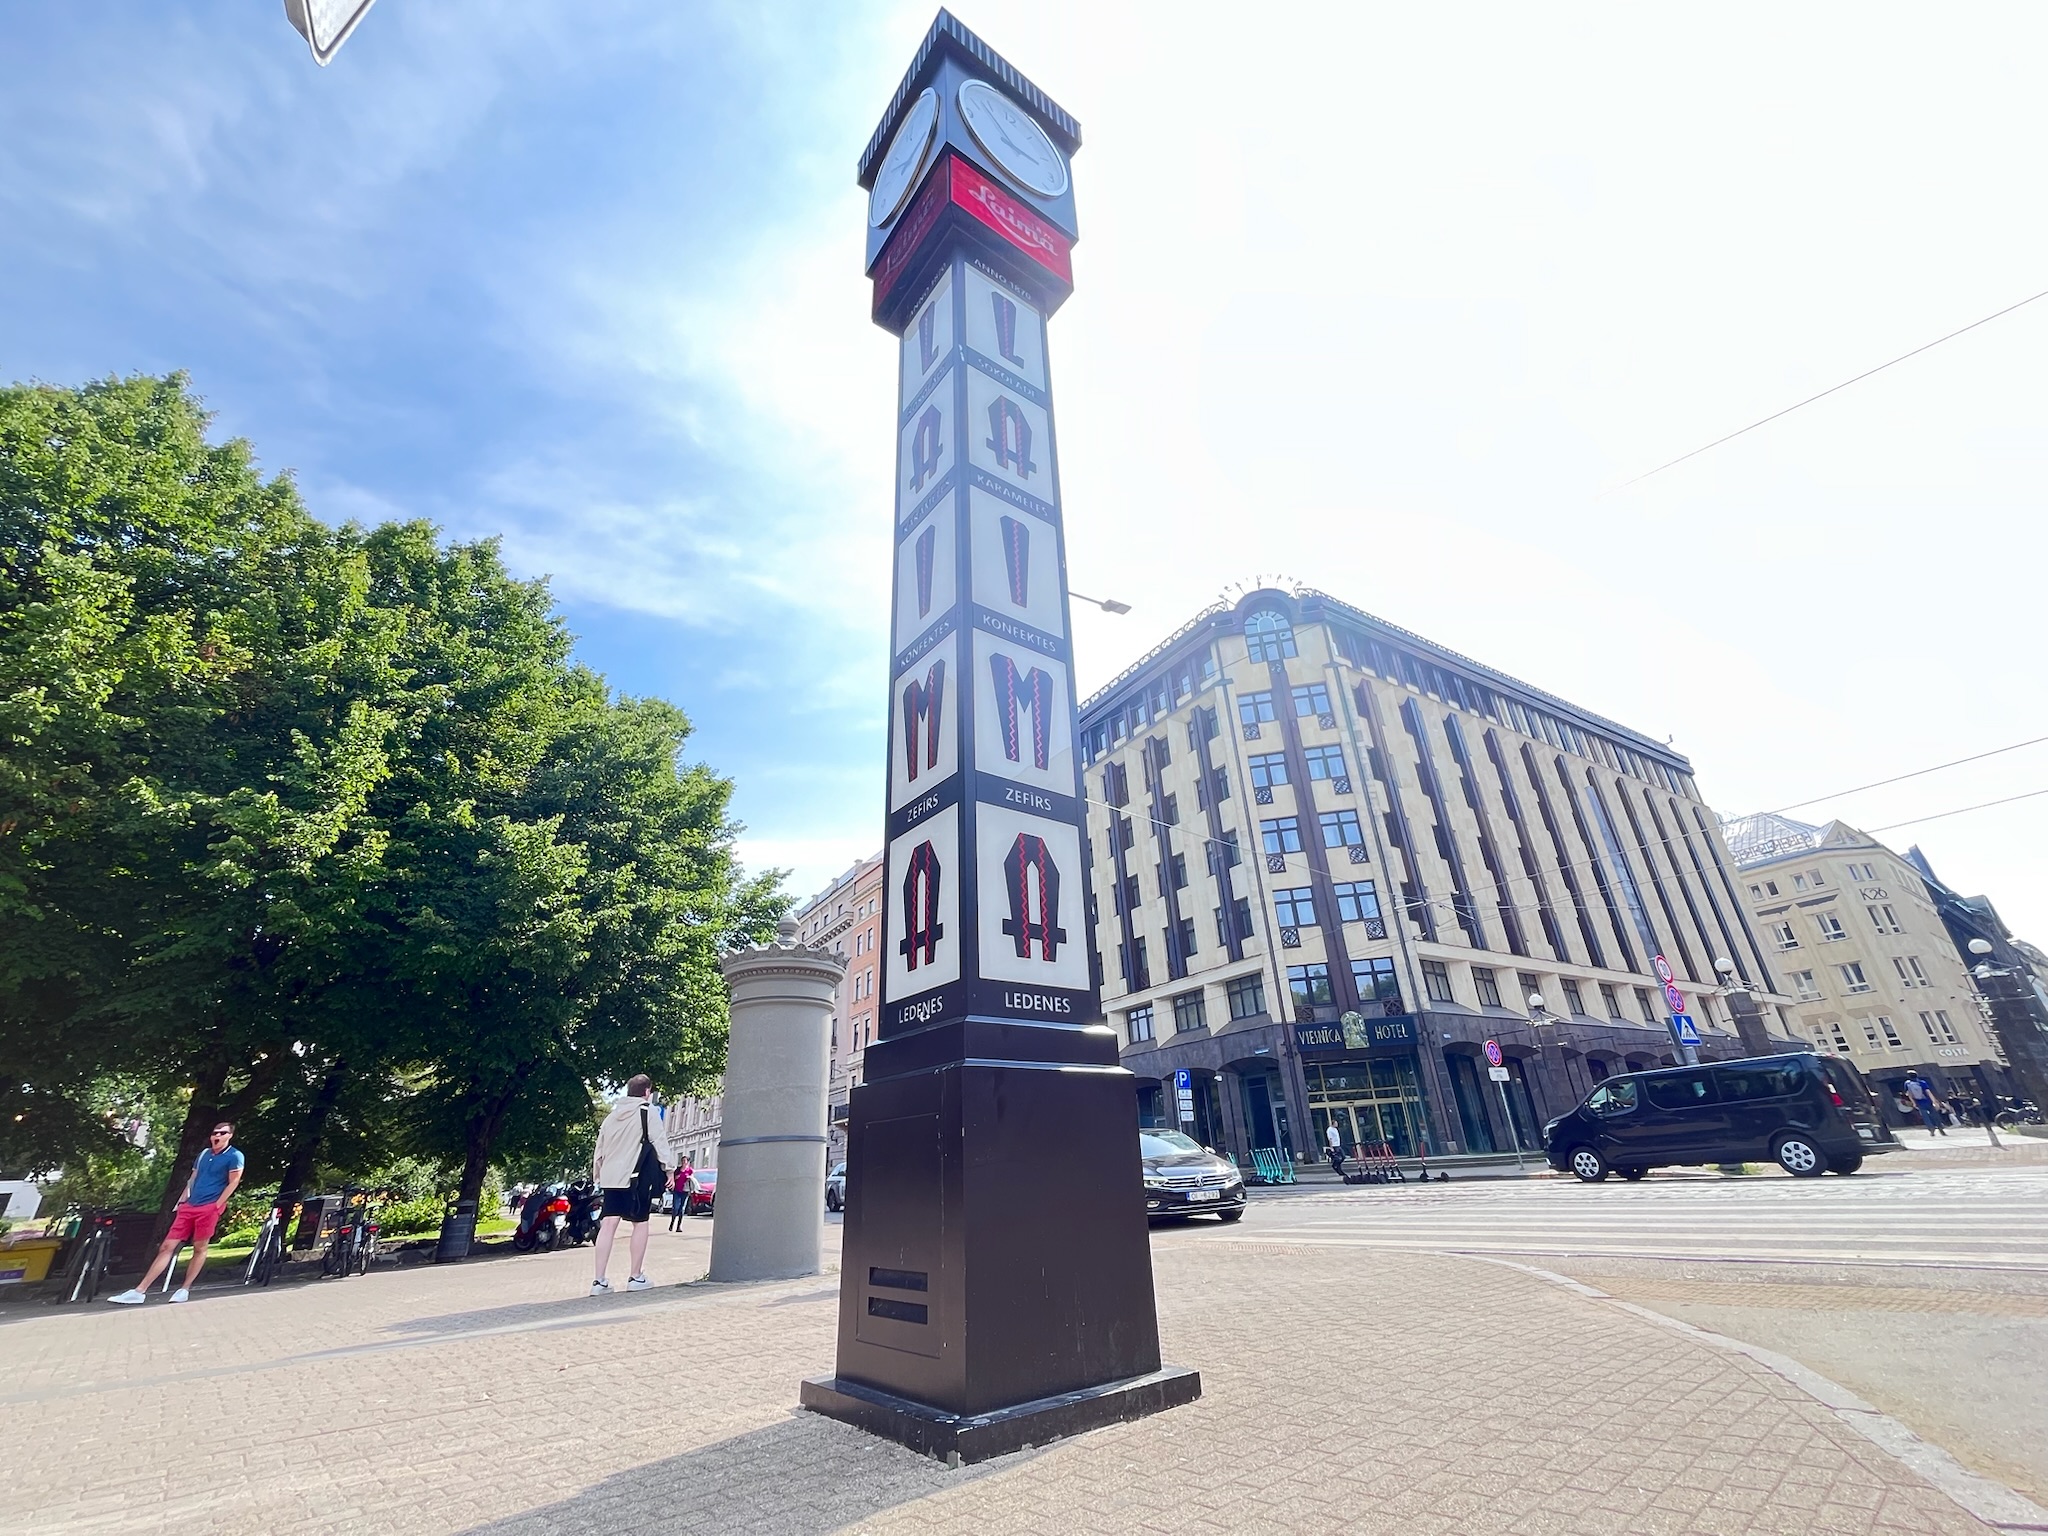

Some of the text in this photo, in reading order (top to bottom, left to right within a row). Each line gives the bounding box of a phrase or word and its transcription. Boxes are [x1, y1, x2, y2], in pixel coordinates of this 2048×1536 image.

[968, 185, 1058, 256] Laima
[974, 258, 1007, 282] ANNO
[977, 474, 1049, 517] KARAMELES
[901, 619, 950, 667] KONFEKTES
[983, 614, 1057, 652] KONFEKTES
[899, 996, 943, 1024] LEDENES
[1005, 992, 1071, 1014] LEDENES
[1298, 1024, 1409, 1045] VIESNĪCA HOTEL
[1939, 1048, 1970, 1057] COSTA
[1178, 1071, 1188, 1087] P
